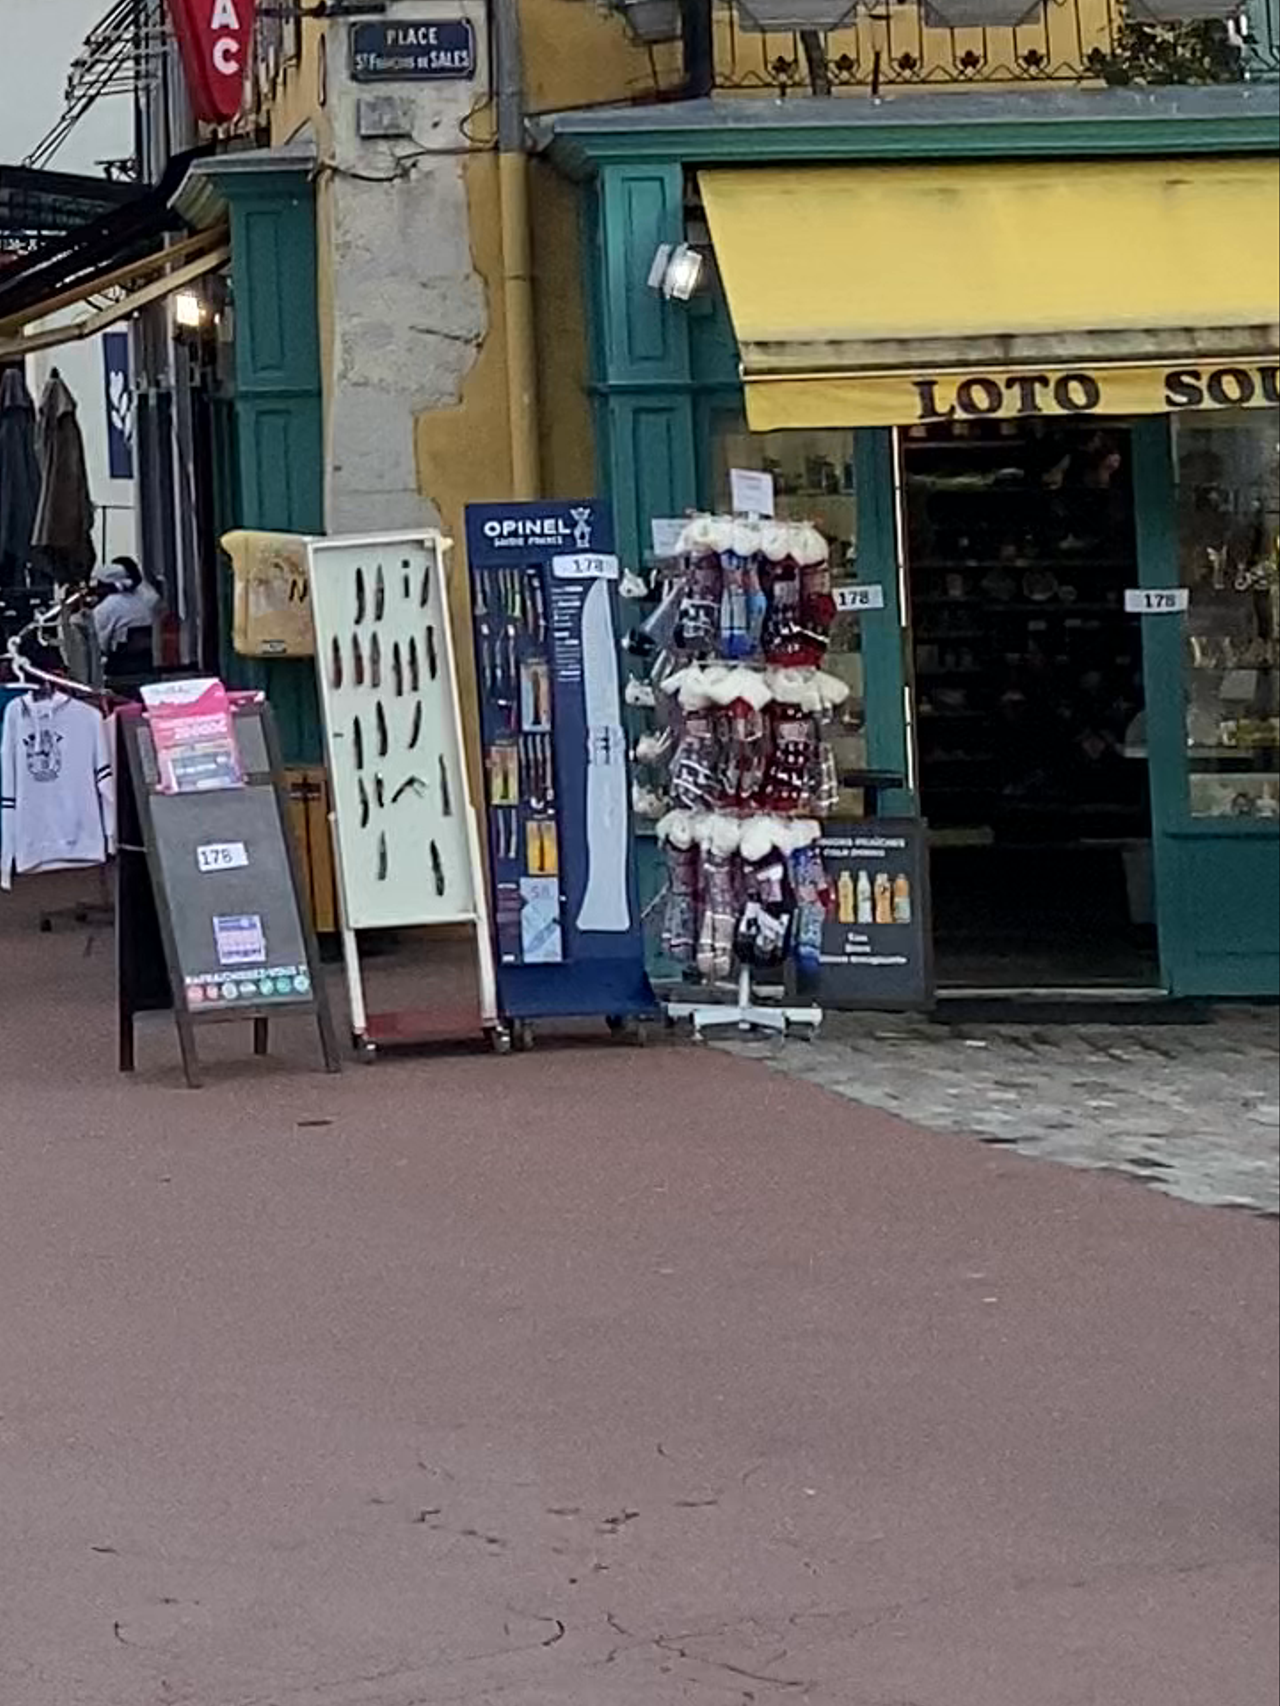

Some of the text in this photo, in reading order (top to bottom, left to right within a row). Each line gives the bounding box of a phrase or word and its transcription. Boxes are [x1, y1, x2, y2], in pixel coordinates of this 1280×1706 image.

[386, 27, 438, 45] PLACE
[429, 50, 470, 69] SALES
[910, 373, 1101, 421] LOTO
[483, 518, 571, 537] OPINEL
[838, 591, 870, 607] 178
[1144, 593, 1176, 608] 178
[200, 848, 234, 867] 178
